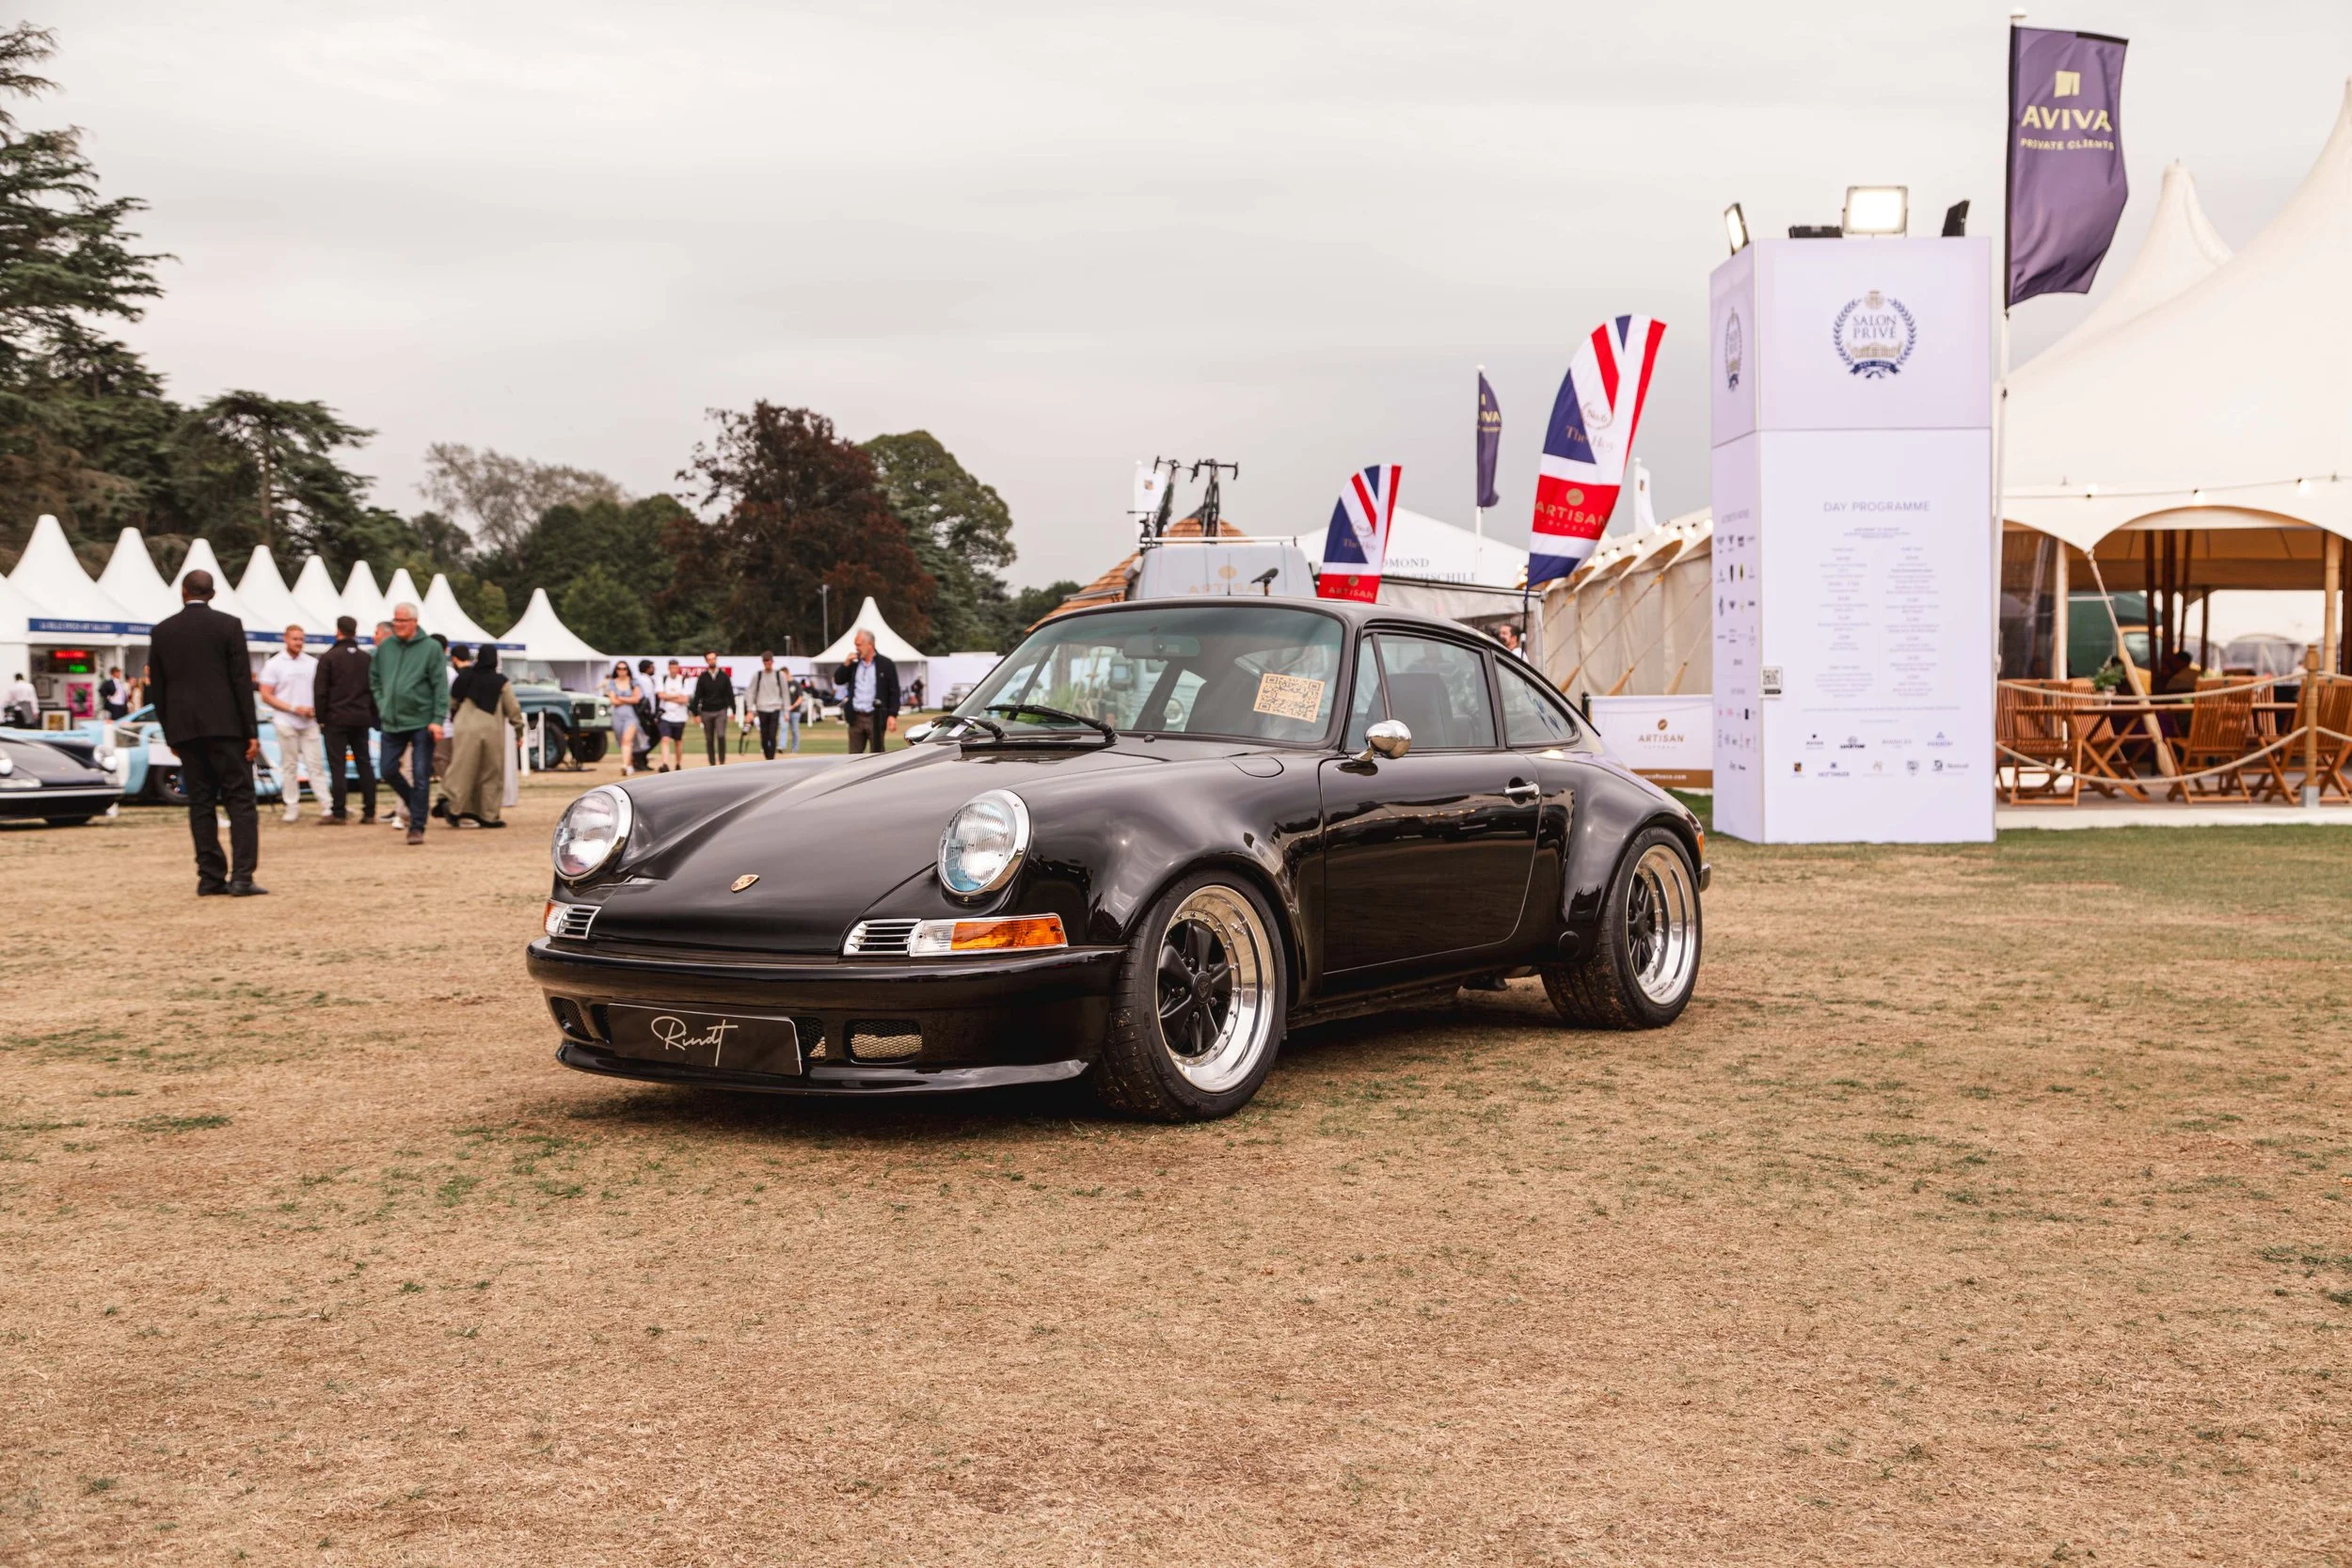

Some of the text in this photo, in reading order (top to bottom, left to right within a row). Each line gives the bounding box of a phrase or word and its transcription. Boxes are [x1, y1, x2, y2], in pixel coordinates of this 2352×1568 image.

[2021, 104, 2113, 133] AVIVA
[2020, 137, 2115, 151] PRIVATE CLIENTS
[1852, 313, 1898, 326] SALON
[1565, 425, 1586, 442] The
[1822, 500, 1931, 513] DAY PROGRAMME
[1327, 586, 1375, 600] ARTISAN
[1638, 733, 1686, 743] ARTISAN
[651, 1016, 739, 1067] Rindt
